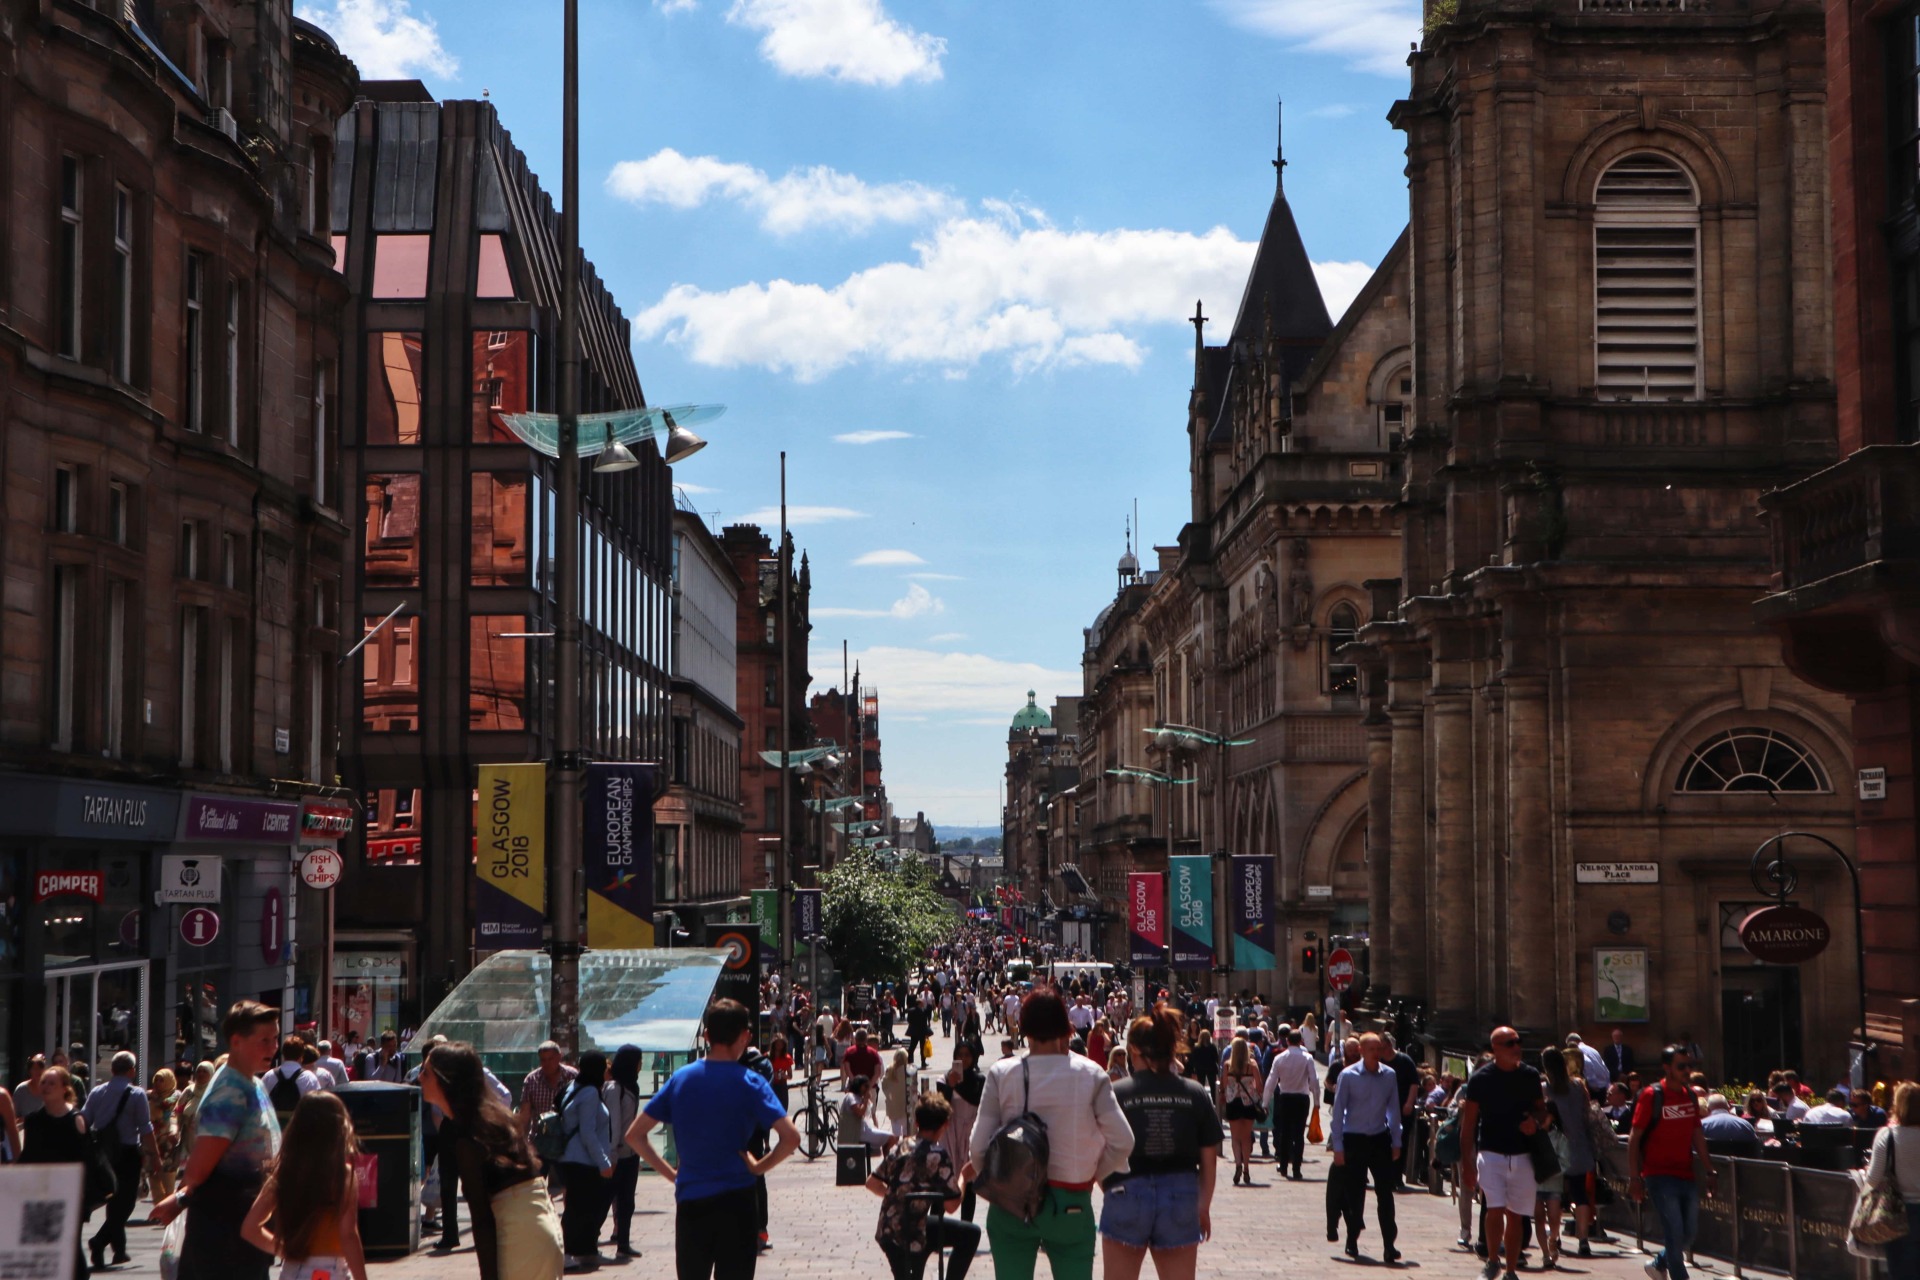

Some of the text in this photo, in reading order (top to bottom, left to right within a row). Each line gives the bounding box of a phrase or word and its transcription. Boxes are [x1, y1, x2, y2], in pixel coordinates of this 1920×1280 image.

[84, 795, 147, 826] TARTAN PLUS
[606, 777, 621, 866] EUROPEAN
[622, 777, 633, 865] CHAMPIONSHIPS
[491, 779, 511, 878] GLASGOW
[310, 855, 331, 864] FISH
[511, 836, 529, 878] 2018
[306, 874, 335, 883] CHIPS
[317, 865, 325, 873] &
[39, 875, 98, 896] CAMPER
[164, 889, 215, 898] TARTAN PLUS
[1181, 865, 1191, 928] GLASGOW
[1245, 864, 1254, 919] EUROPEAN
[802, 894, 810, 932] EUROPEAN
[1137, 880, 1146, 932] GLASGOW
[1192, 899, 1203, 927] 2018
[482, 924, 499, 933] HM
[764, 918, 772, 936] 2018
[1147, 909, 1156, 932] 2018
[1749, 928, 1826, 943] AMARONE
[346, 957, 397, 968] LOOK
[1612, 953, 1642, 966] SGT
[1142, 1096, 1172, 1104] IRELAND
